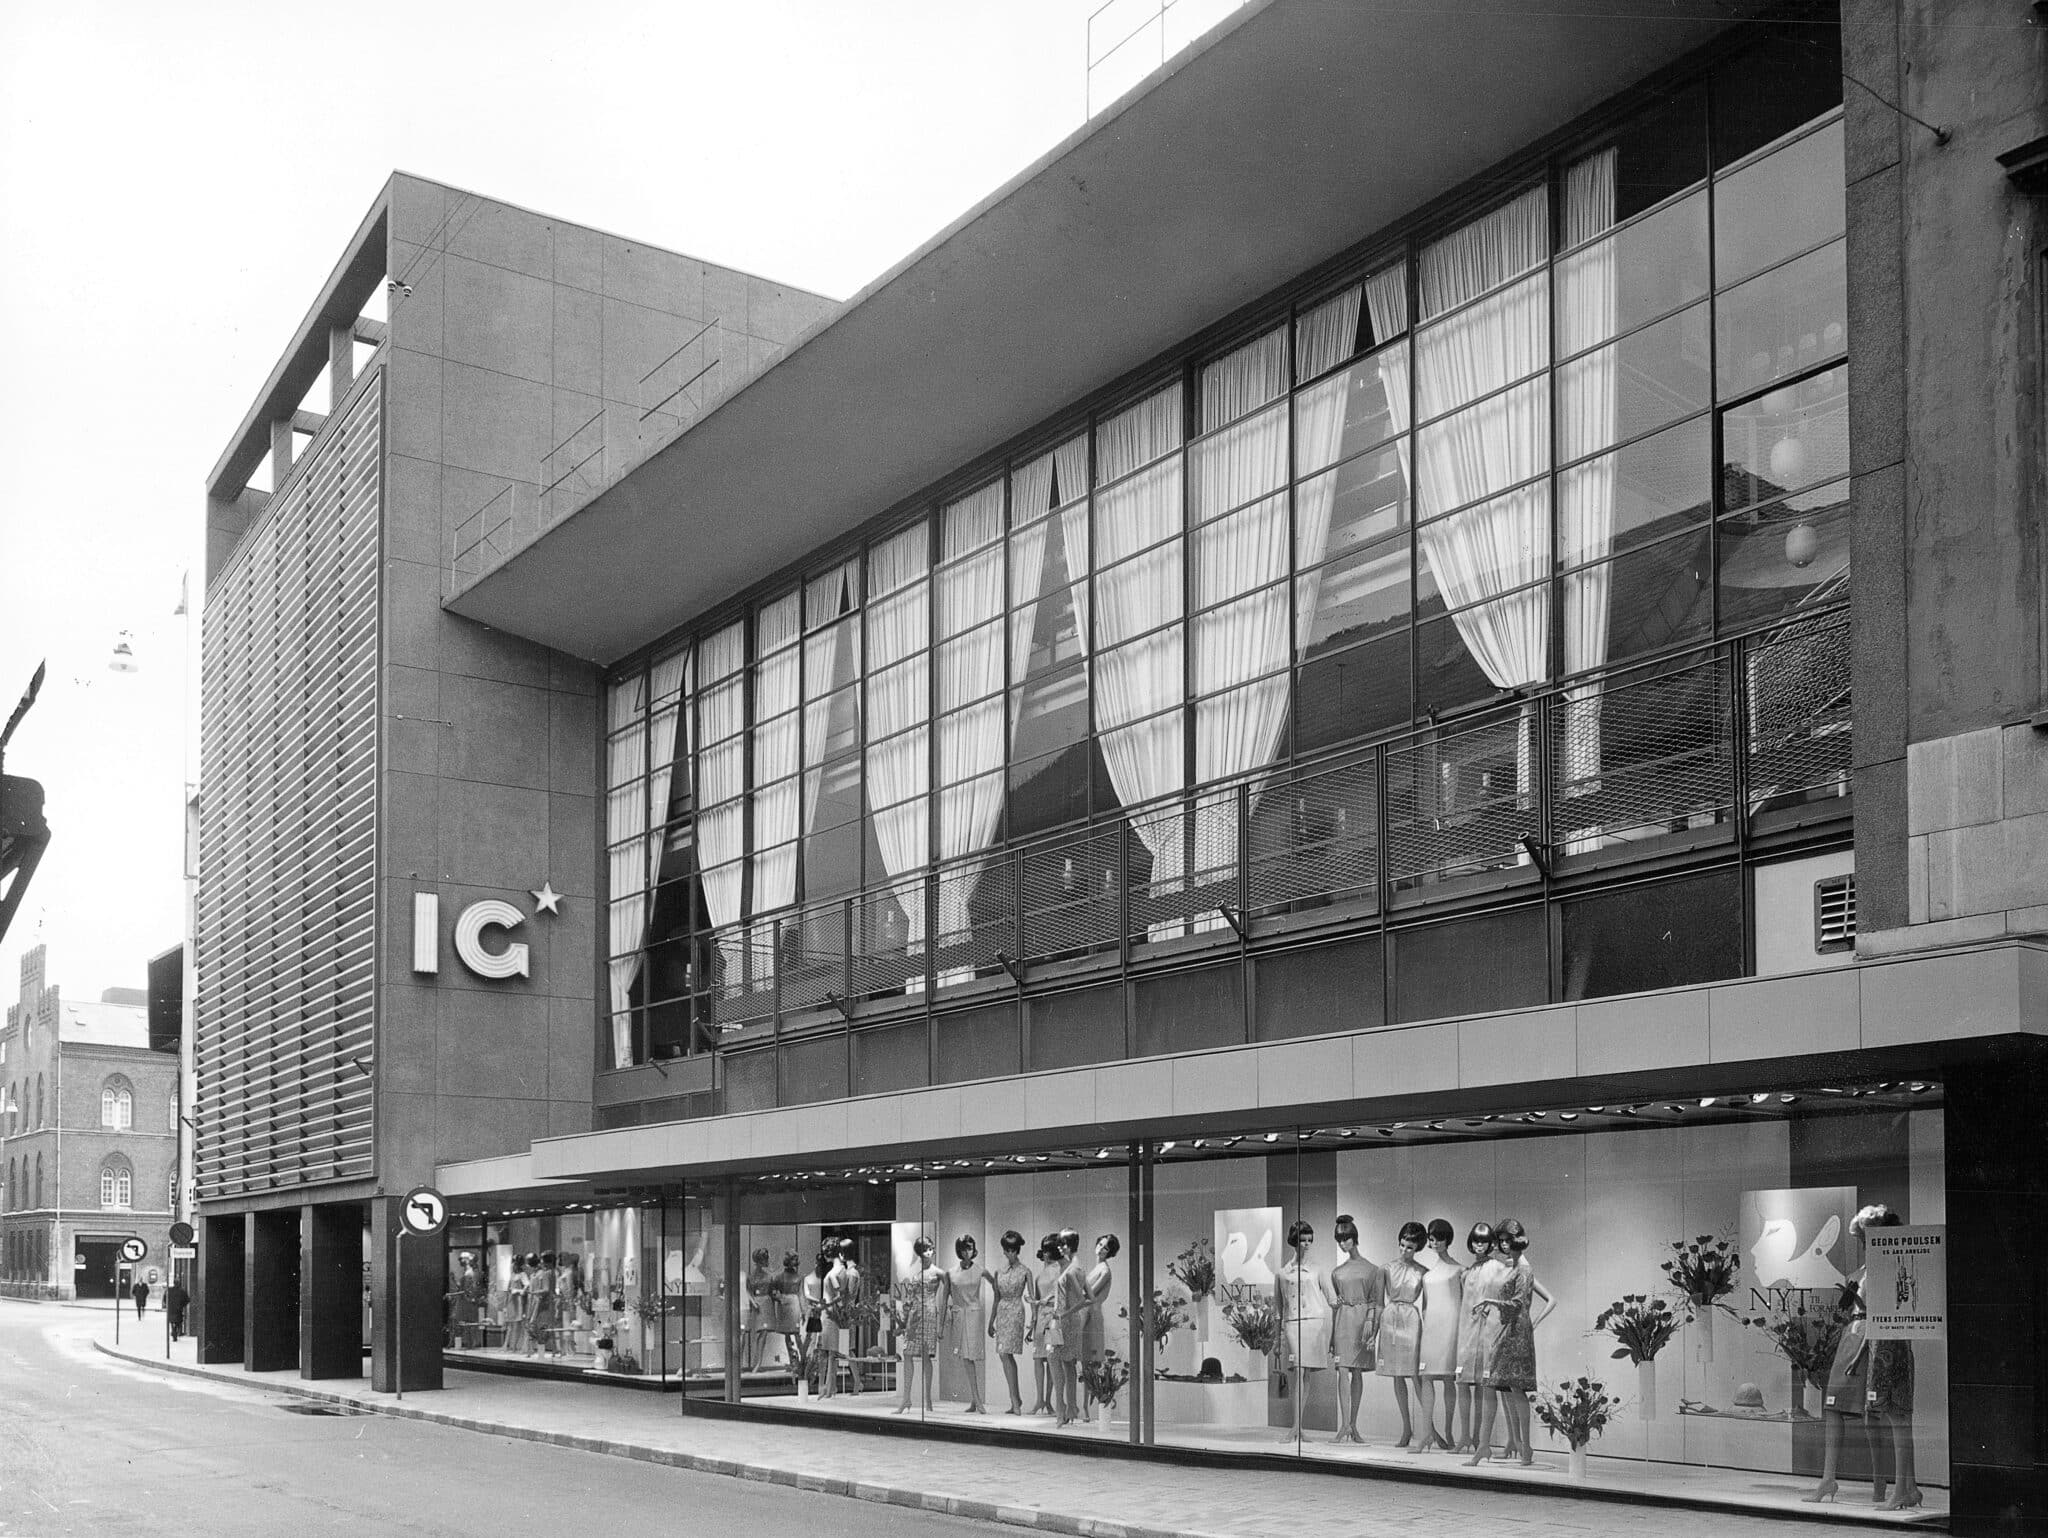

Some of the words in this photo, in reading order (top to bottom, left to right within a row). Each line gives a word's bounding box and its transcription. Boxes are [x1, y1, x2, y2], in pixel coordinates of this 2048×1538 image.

[414, 892, 529, 979] IG
[1871, 1237, 1899, 1247] GEORG
[1901, 1235, 1941, 1246] POULSEN
[1220, 1284, 1256, 1302] NYT
[1749, 1287, 1812, 1311] NYT
[1894, 1315, 1943, 1323] STIFTSMUSEUM
